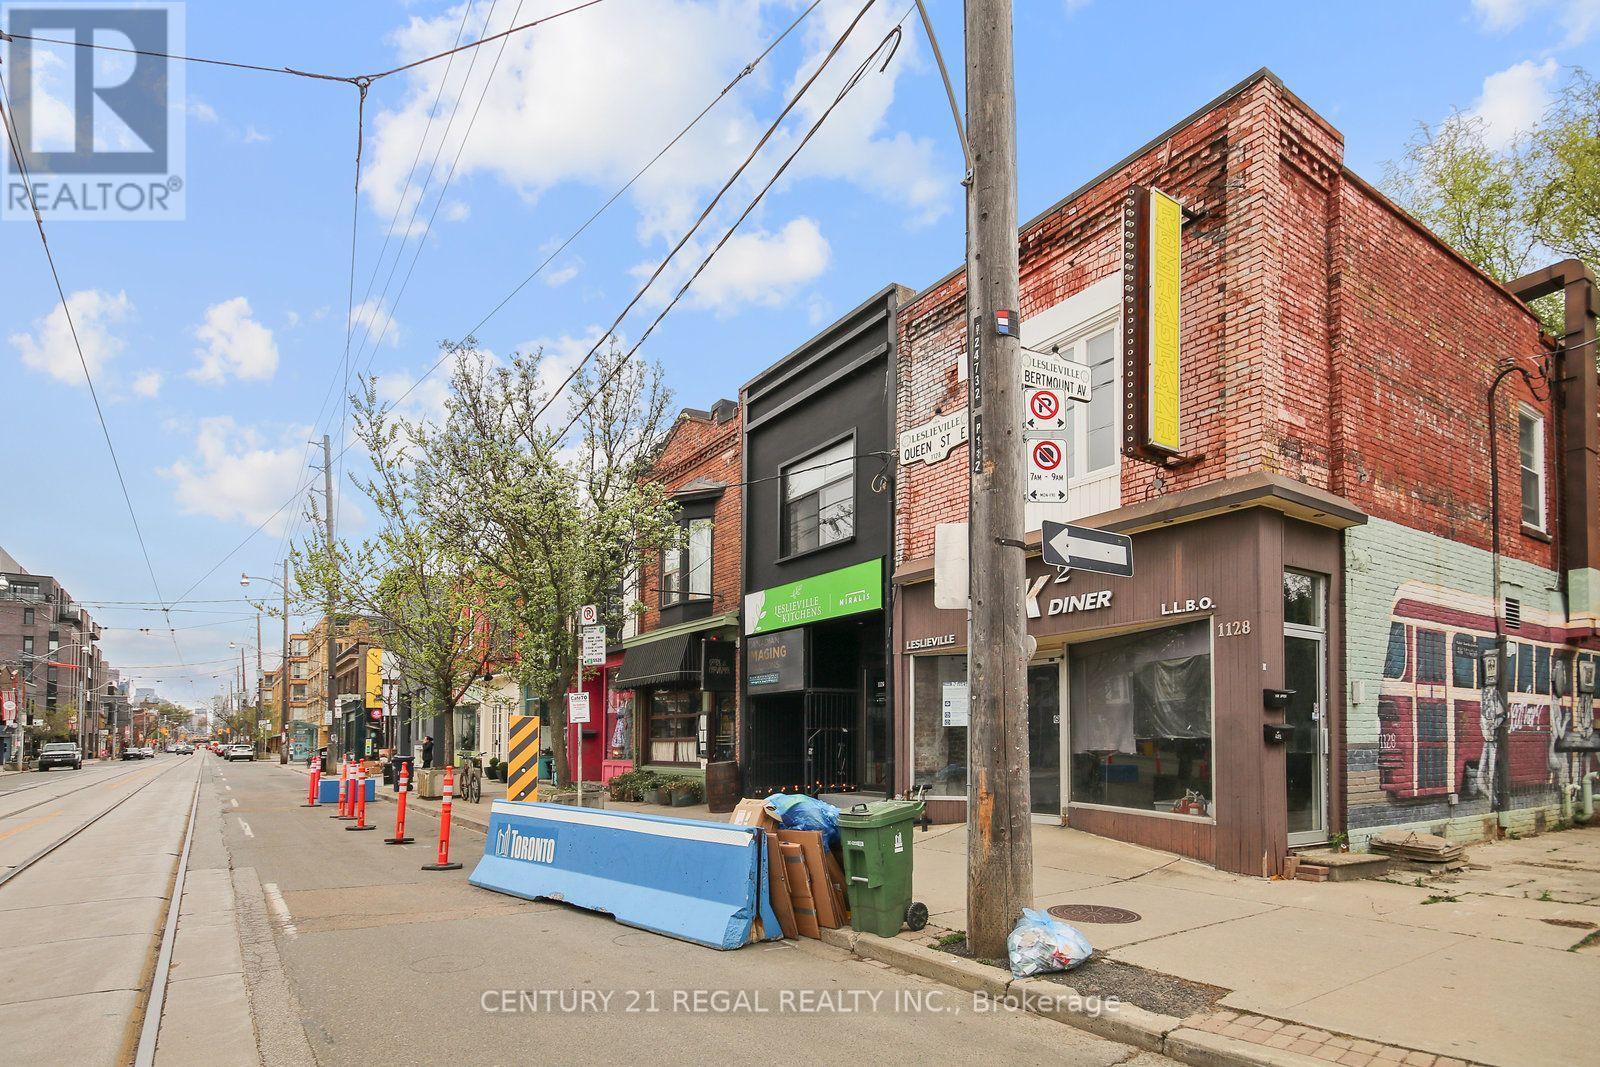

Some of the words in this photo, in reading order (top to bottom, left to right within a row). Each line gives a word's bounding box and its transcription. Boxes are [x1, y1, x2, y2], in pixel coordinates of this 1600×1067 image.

[1032, 358, 1080, 379] LESLIEVILLE
[1024, 369, 1075, 394] BERTMOUNT
[1077, 384, 1087, 396] AV
[911, 417, 960, 443] LESLIEVILLE
[904, 440, 932, 461] QUEEN
[940, 433, 951, 448] ST
[1030, 472, 1042, 481] 7AM
[1051, 472, 1064, 481] 9AM
[774, 596, 819, 617] LESLIEVILLE
[839, 592, 870, 606] MIRALIS
[1048, 590, 1113, 616] DINER
[1161, 597, 1217, 615] L.L.B.O.
[782, 606, 822, 622] KITCHENS
[1217, 620, 1251, 637] 1128
[906, 634, 955, 650] LESLIEVILLE
[1380, 733, 1396, 749] 1128
[511, 828, 555, 864] TORONTO
